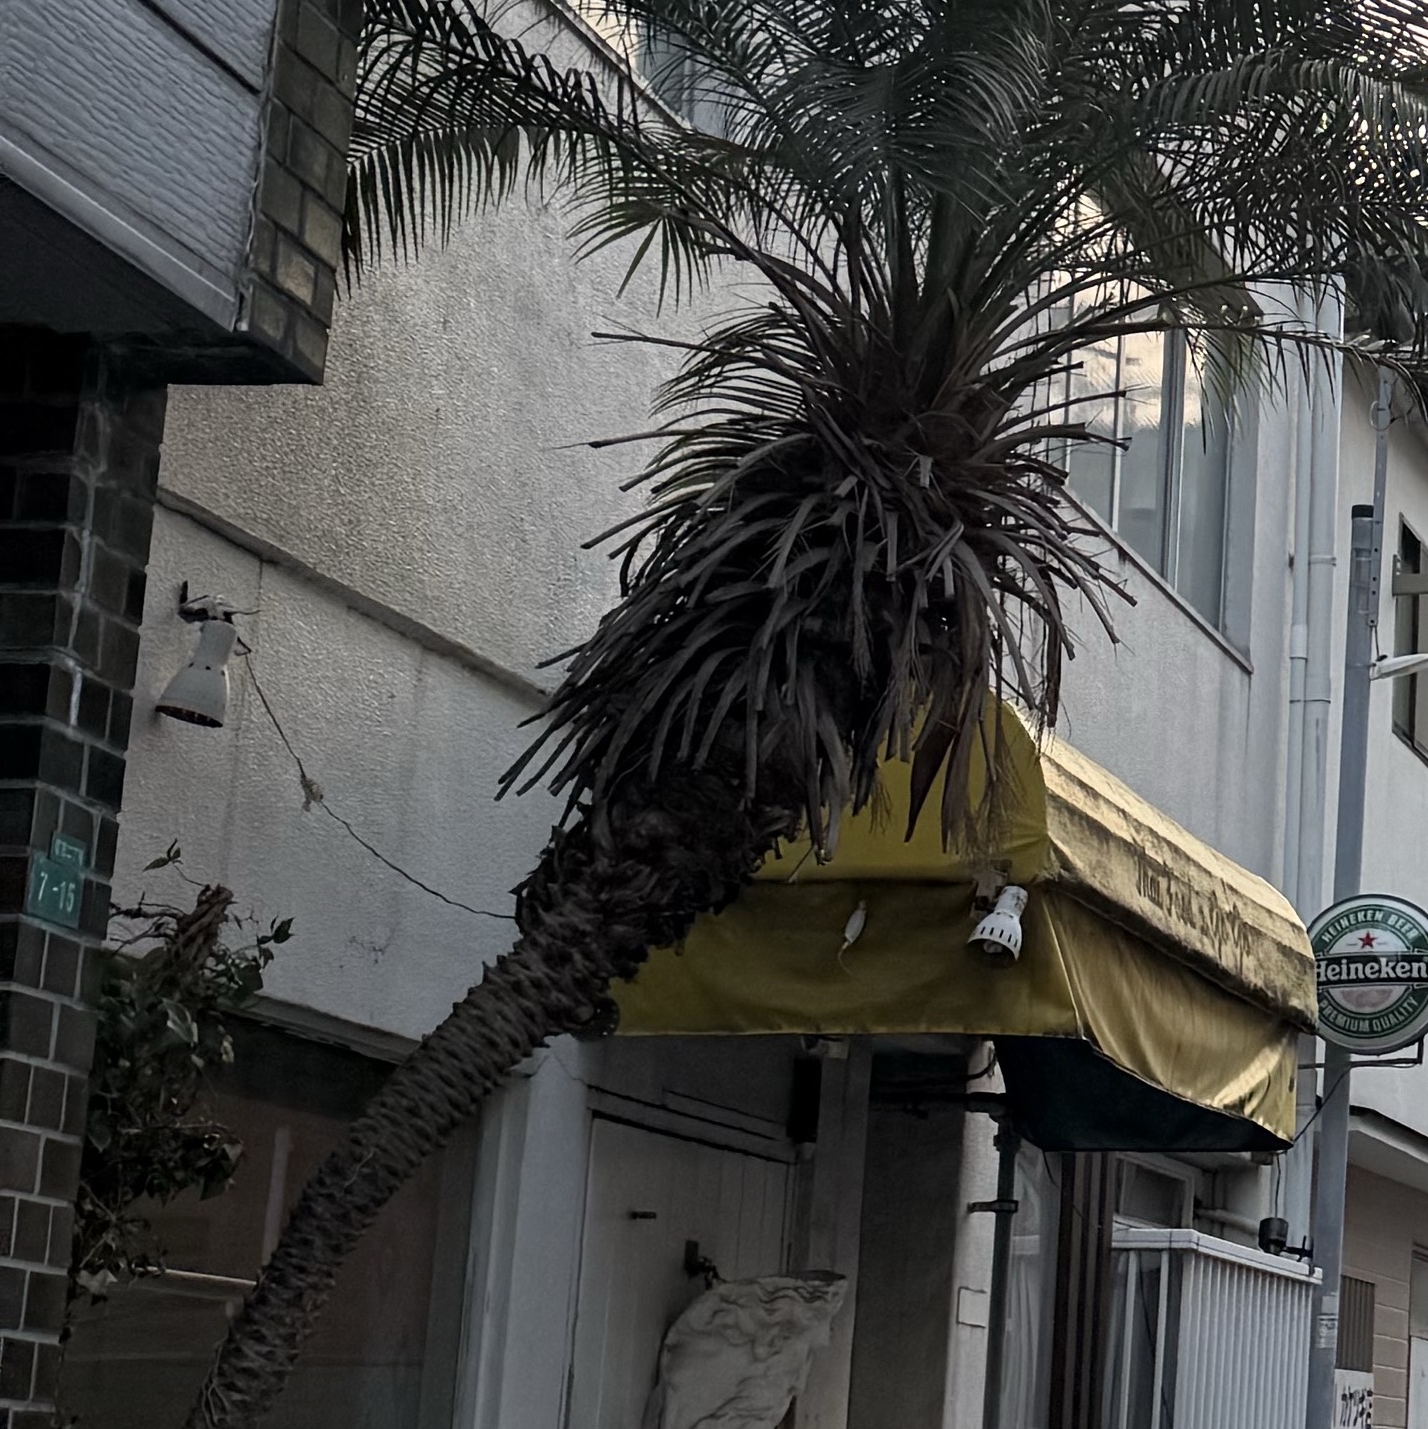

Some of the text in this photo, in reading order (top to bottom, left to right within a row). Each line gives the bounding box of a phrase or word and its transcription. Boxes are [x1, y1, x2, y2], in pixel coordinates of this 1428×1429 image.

[1321, 910, 1420, 943] HEINEKEN BEER
[1315, 956, 1428, 983] Heineken
[1319, 995, 1420, 1033] PREMIUM QUALITY
